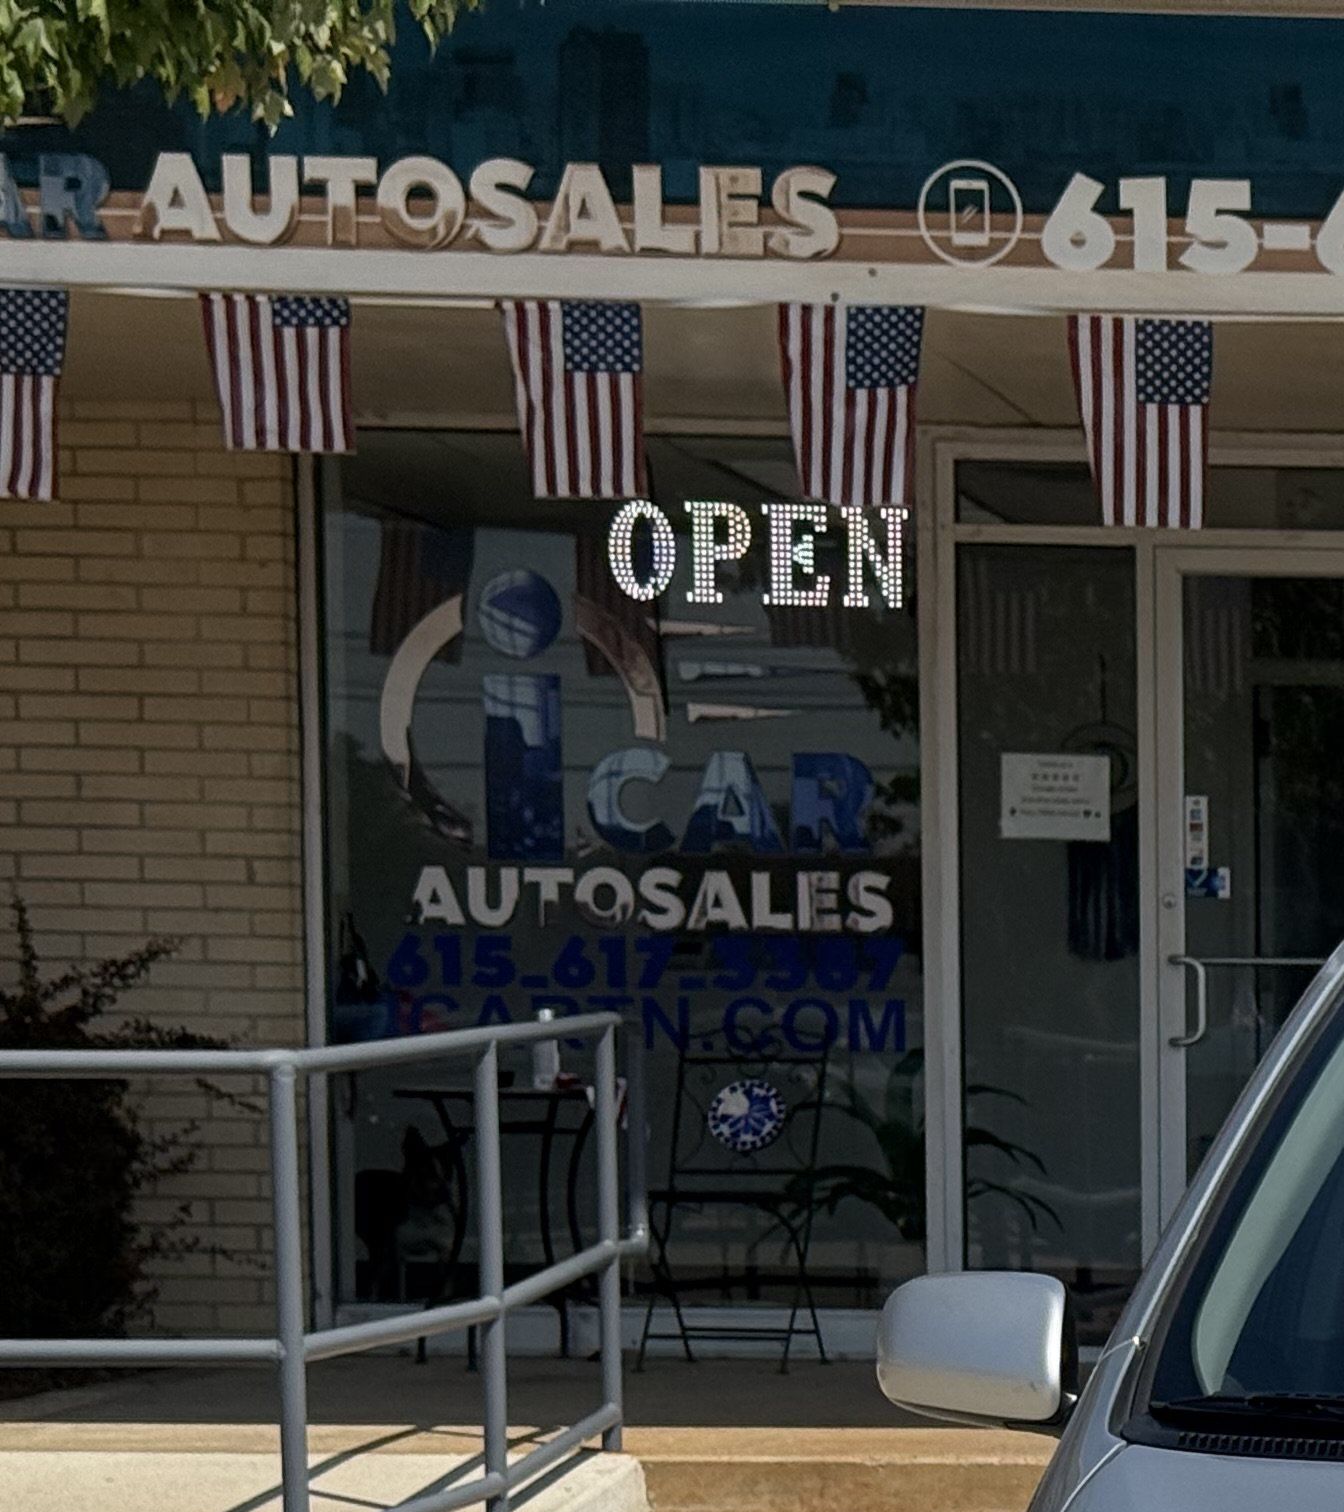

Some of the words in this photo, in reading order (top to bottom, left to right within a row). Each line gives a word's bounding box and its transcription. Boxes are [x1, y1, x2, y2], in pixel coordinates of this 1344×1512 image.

[133, 152, 840, 260] AUTOSALES
[607, 499, 911, 609] OPEN
[413, 866, 895, 933] AUTOSALES
